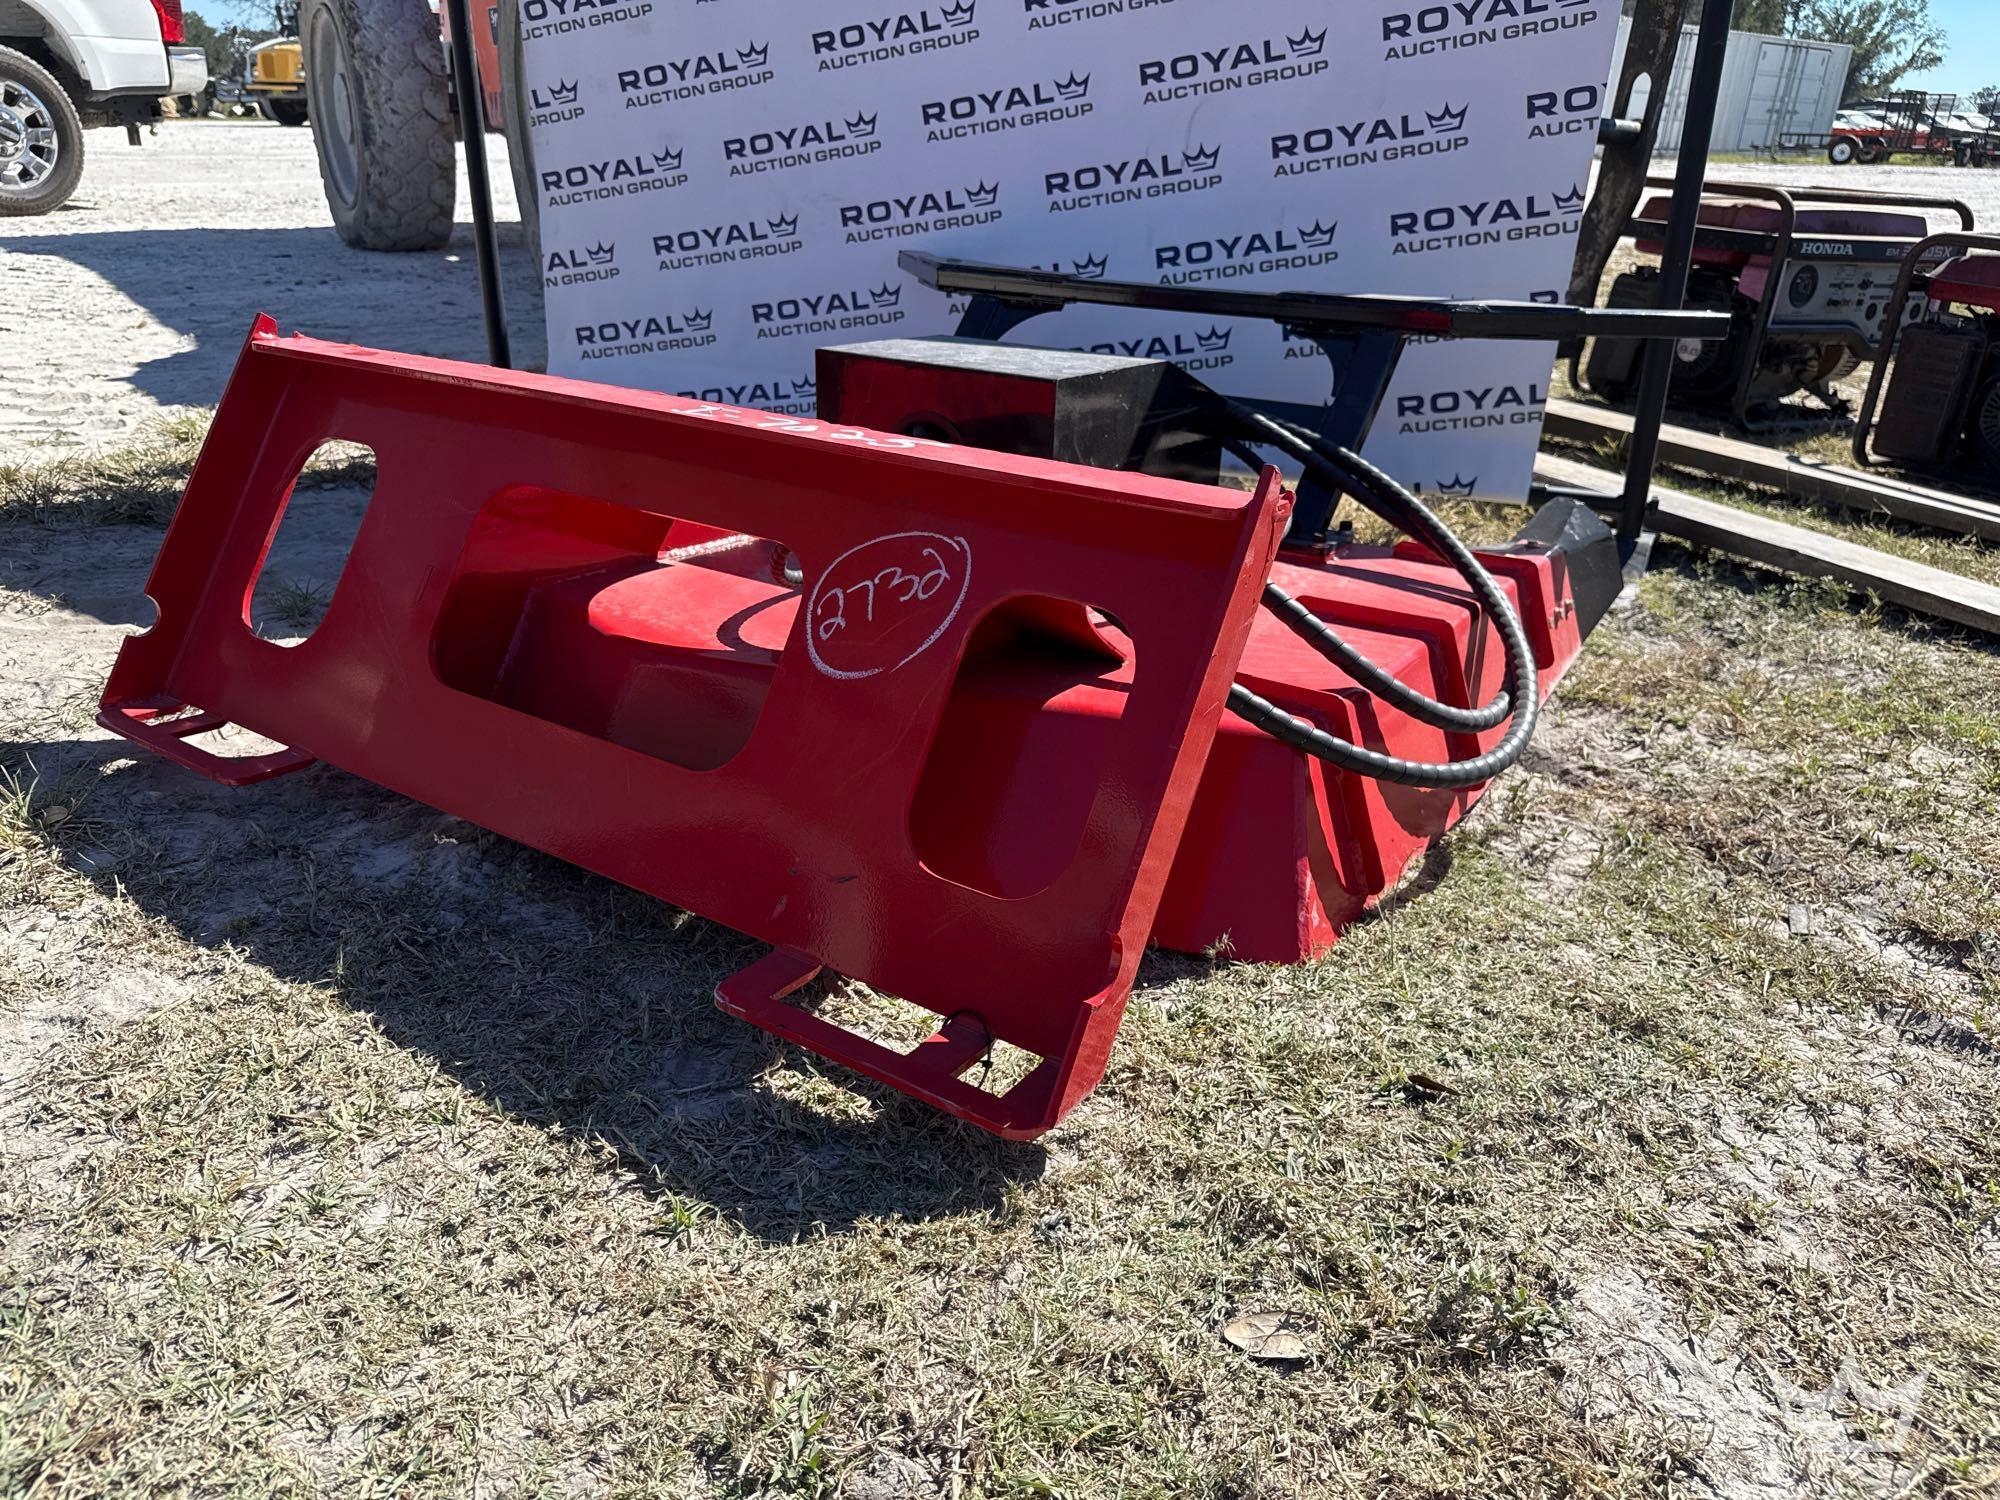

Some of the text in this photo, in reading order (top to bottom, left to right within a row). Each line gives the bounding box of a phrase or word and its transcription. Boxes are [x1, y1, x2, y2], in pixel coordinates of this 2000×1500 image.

[588, 3, 653, 27] GROUP
[812, 10, 942, 54] ROYAL
[1028, 0, 1124, 30] AUCTION
[1382, 0, 1549, 41] ROYAL
[818, 29, 980, 72] AUCTION GROUP
[1384, 10, 1597, 61] AUCTION GROUP
[618, 52, 738, 92] ROYAL
[1139, 40, 1286, 86] ROYAL
[625, 70, 774, 109] AUCTION GROUP
[1143, 60, 1329, 105] AUCTION GROUP
[921, 83, 1055, 125] ROYAL
[723, 122, 846, 160] ROYAL
[927, 103, 1093, 143] AUCTION GROUP
[1271, 115, 1424, 159] ROYAL
[541, 156, 655, 192] ROYAL
[729, 140, 881, 177] AUCTION GROUP
[1045, 155, 1182, 195] ROYAL
[1274, 136, 1469, 178] AUCTION GROUP
[549, 174, 688, 208] AUCTION GROUP
[840, 191, 966, 227] ROYAL
[1049, 175, 1222, 213] AUCTION GROUP
[845, 210, 1003, 244] AUCTION GROUP
[1391, 196, 1550, 237] ROYAL
[653, 222, 768, 255] ROYAL
[659, 240, 803, 271] AUCTION GROUP
[1155, 230, 1297, 269] ROYAL
[1392, 230, 1500, 255] AUCTION
[1801, 242, 1853, 255] HONDA
[562, 267, 620, 286] GROUP
[1159, 251, 1338, 286] AUCTION GROUP
[752, 291, 870, 323] ROYAL
[757, 311, 904, 339] AUCTION GROUP
[576, 316, 684, 346] ROYAL
[581, 334, 716, 361] AUCTION GROUP
[1174, 355, 1233, 372] ROUP
[1396, 384, 1547, 417] ROYAL
[1399, 414, 1504, 434] AUCTION
[818, 548, 951, 641] 2732
